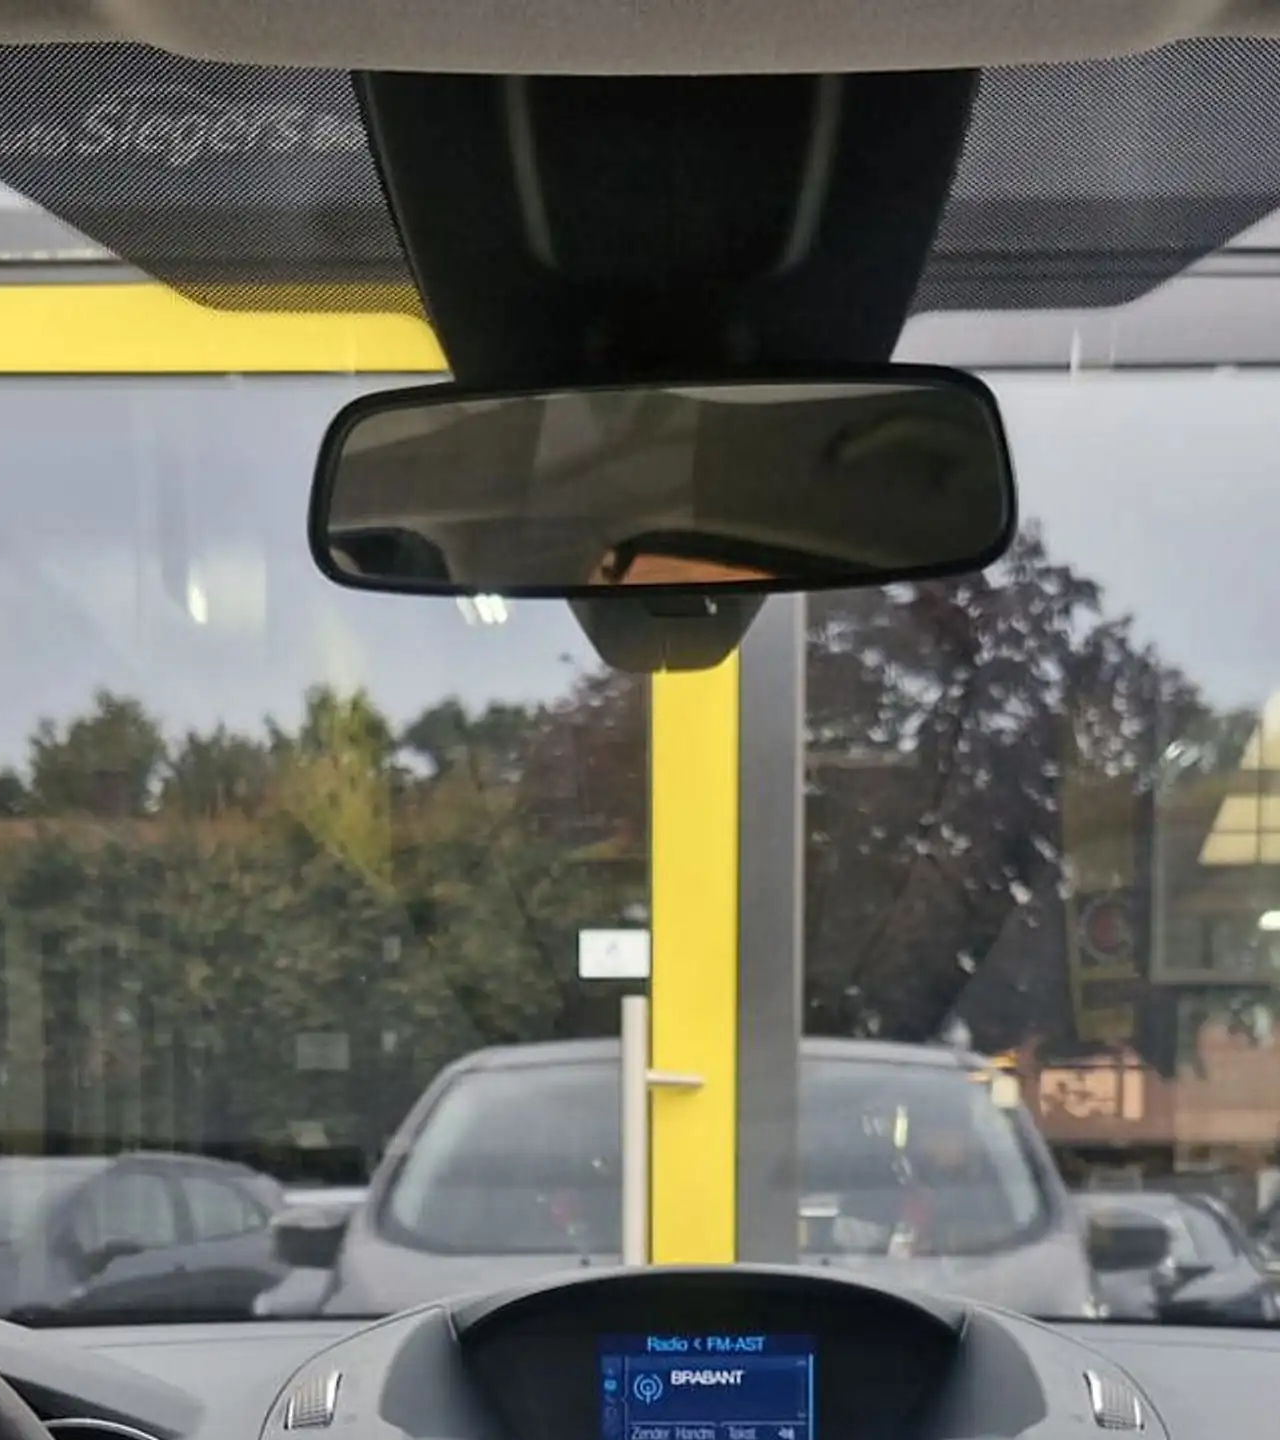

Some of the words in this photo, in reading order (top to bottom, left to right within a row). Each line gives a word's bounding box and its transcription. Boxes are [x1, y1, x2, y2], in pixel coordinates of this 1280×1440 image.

[76, 98, 305, 168] Siegers
[646, 1336, 688, 1351] Radio
[706, 1336, 766, 1351] FM-AST
[670, 1369, 744, 1385] BRABANT
[630, 1427, 670, 1440] Zender
